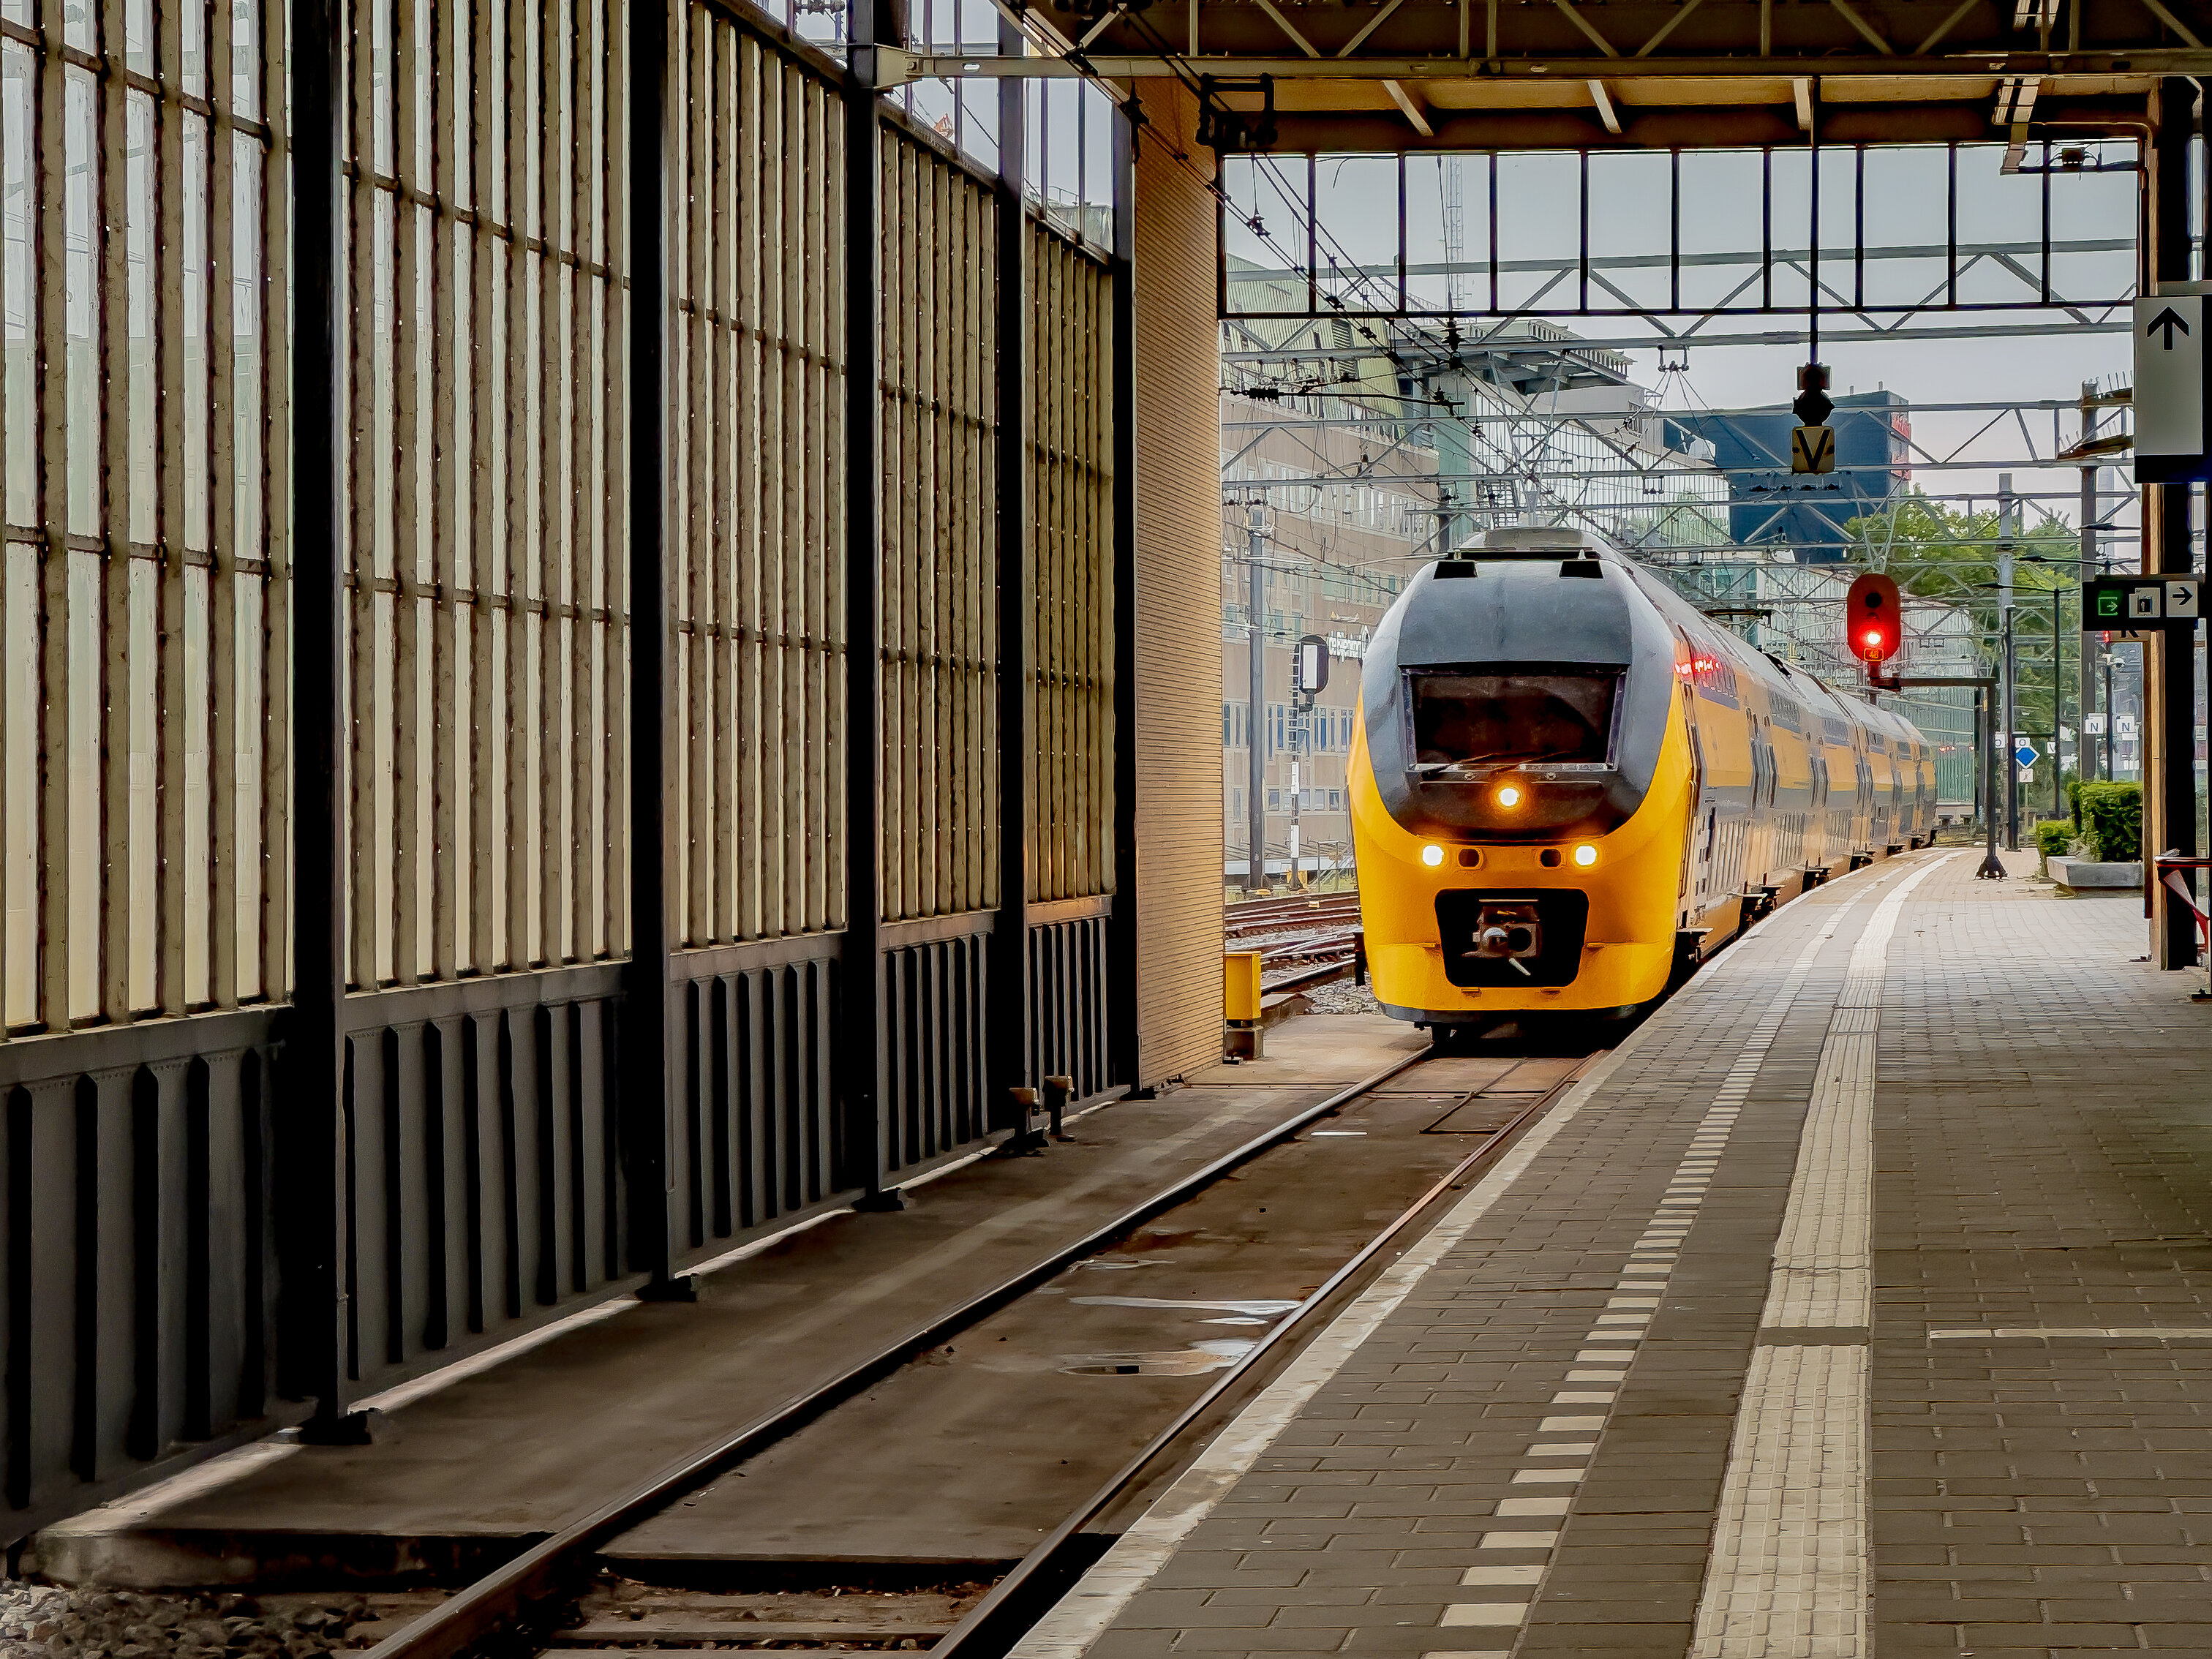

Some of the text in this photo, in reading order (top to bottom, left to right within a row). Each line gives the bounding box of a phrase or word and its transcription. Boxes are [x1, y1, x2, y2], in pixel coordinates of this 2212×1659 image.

[1795, 429, 1831, 470] V
[2090, 722, 2099, 732] N
[2121, 722, 2130, 731] N
